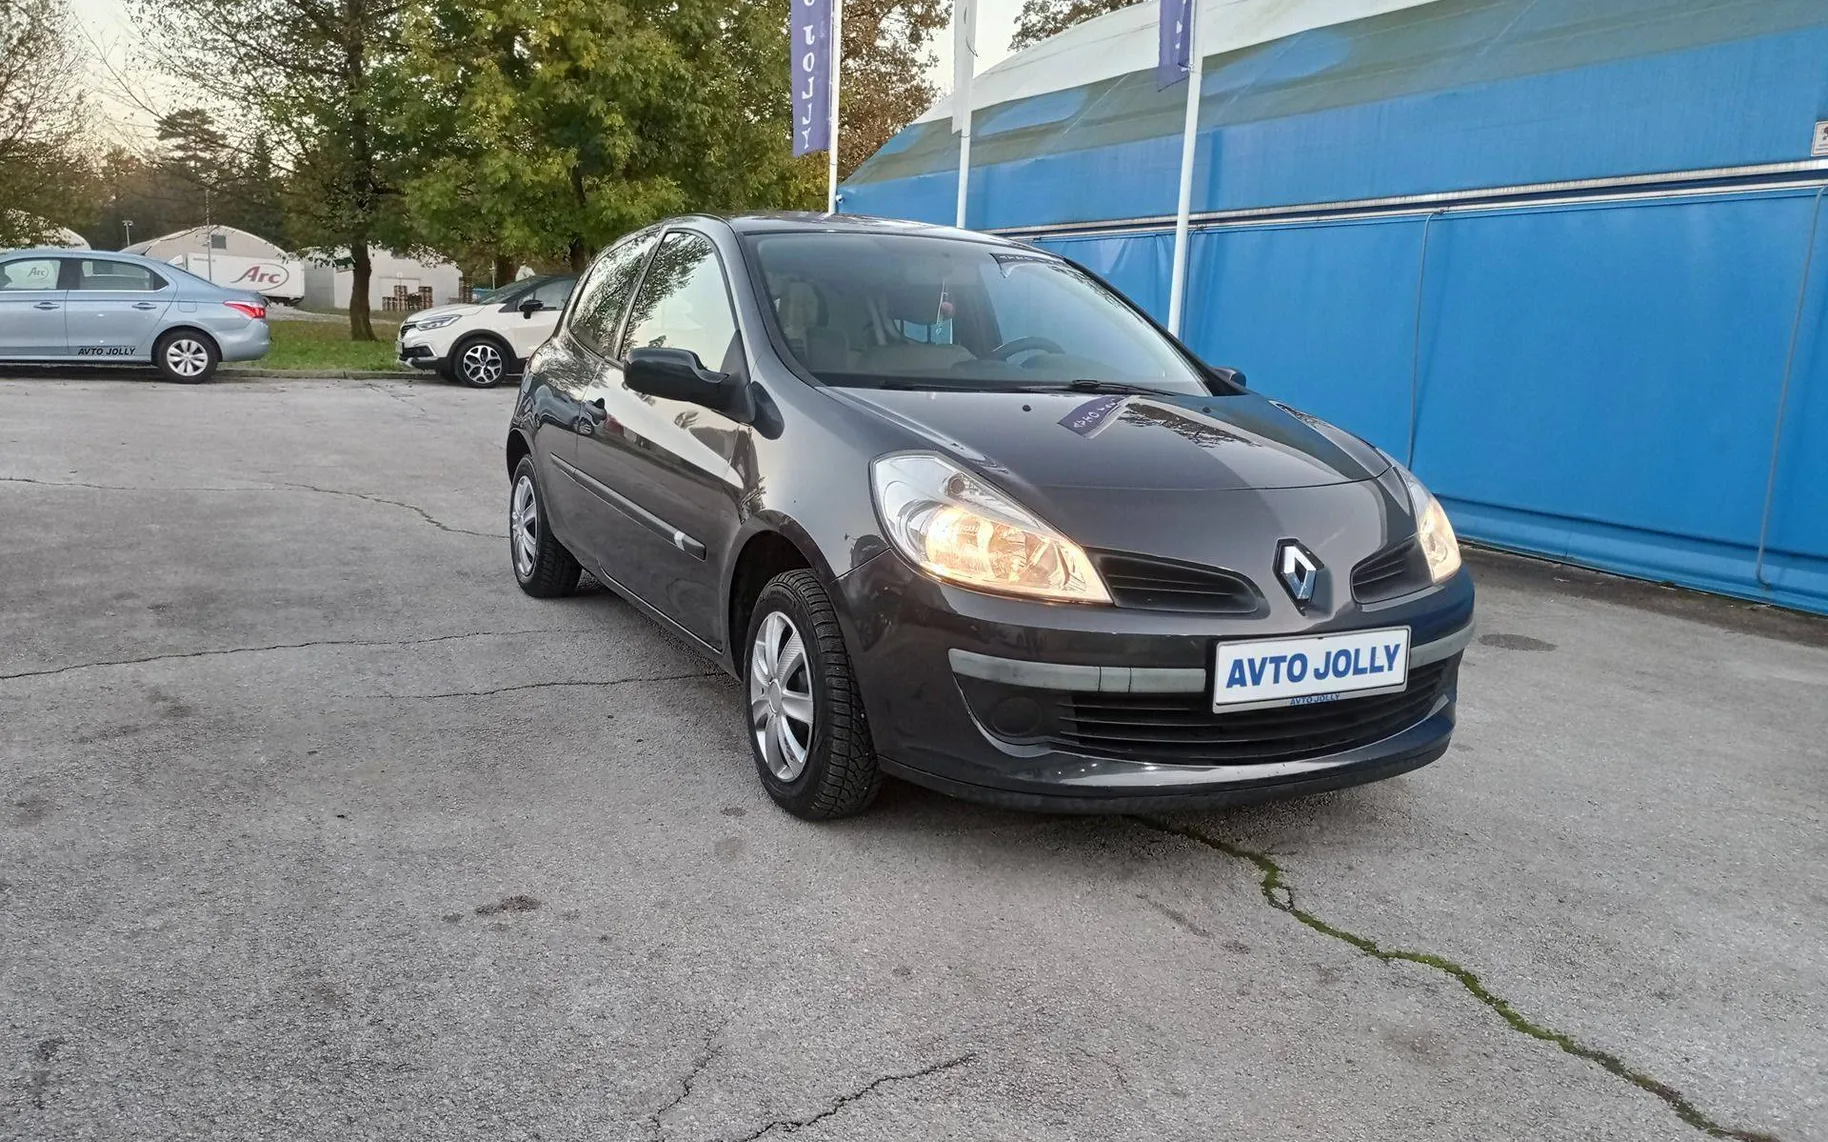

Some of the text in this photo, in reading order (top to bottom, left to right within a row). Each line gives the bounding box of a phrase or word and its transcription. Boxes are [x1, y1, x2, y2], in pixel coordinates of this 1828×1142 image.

[27, 267, 46, 278] Arc
[230, 265, 281, 284] Arc
[78, 348, 136, 356] AVTO JOLLY
[1226, 644, 1401, 688] AVTO JOLLY
[1290, 693, 1340, 705] AVTO JOLLY
